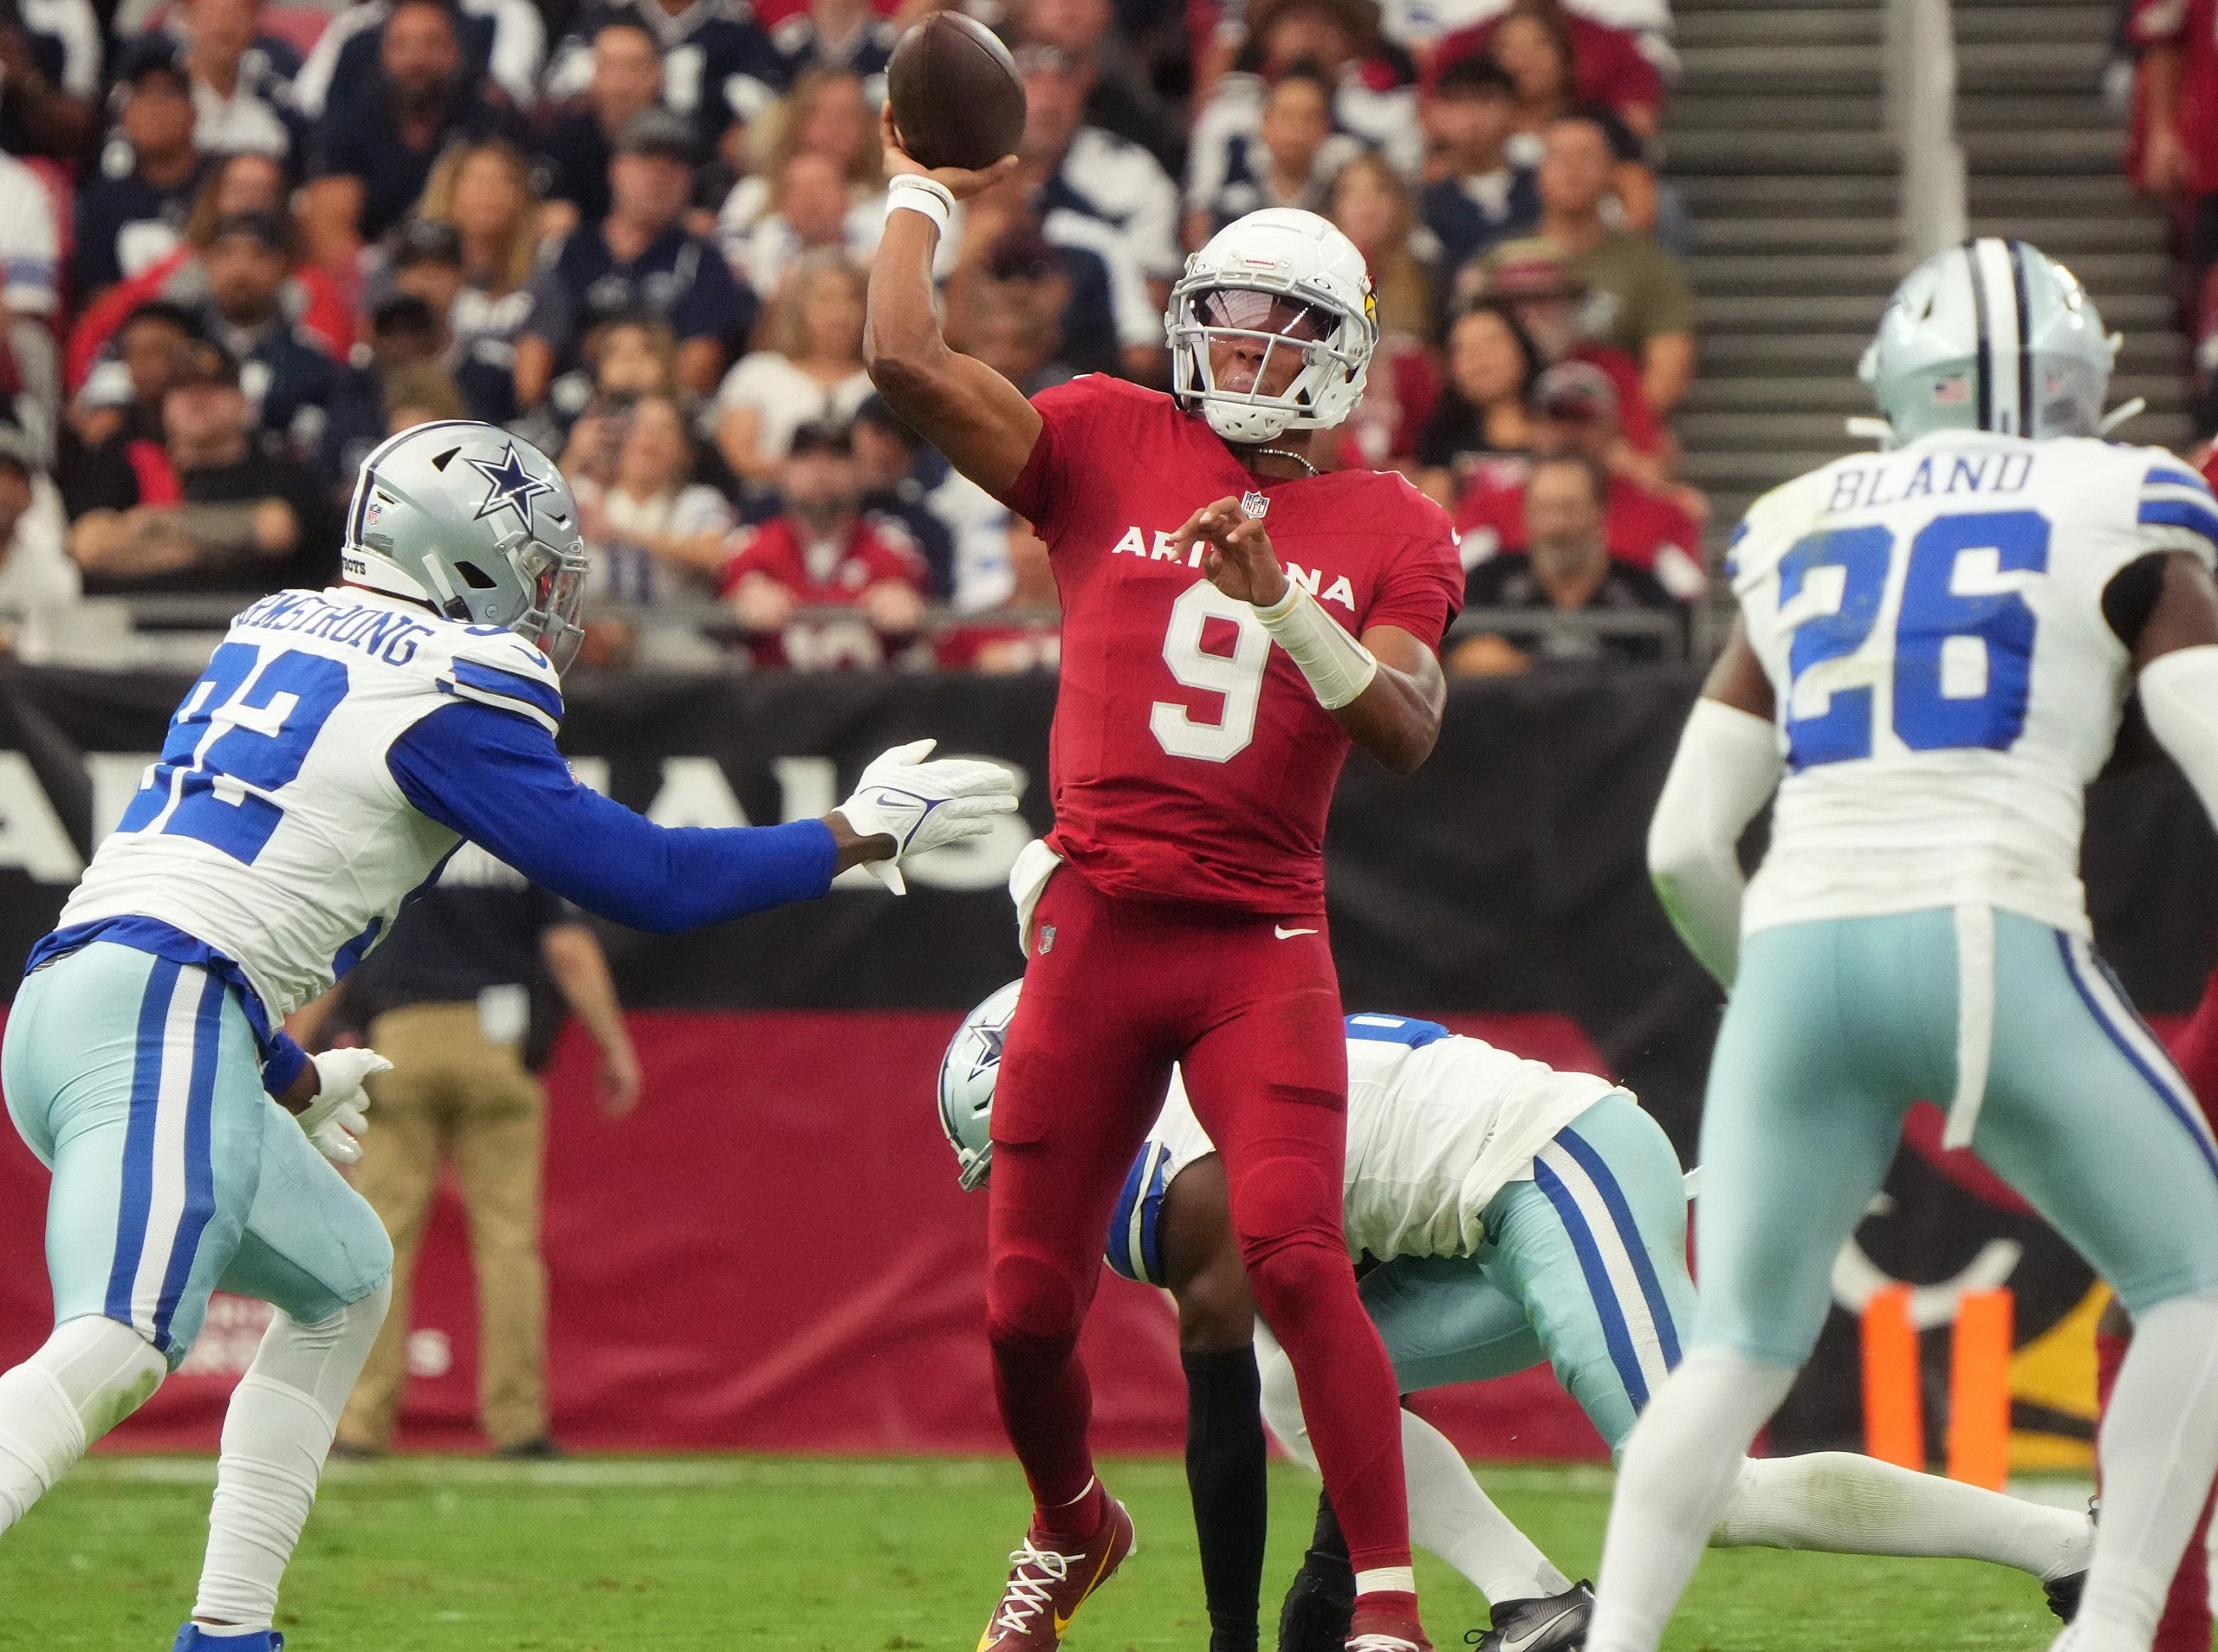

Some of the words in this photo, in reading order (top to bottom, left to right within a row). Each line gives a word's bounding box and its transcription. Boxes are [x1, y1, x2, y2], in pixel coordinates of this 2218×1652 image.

[1245, 499, 1263, 514] NFL
[1826, 453, 2034, 514] BLAND
[1112, 526, 1356, 612] ARINA
[237, 592, 436, 667] RMSTRONG
[1149, 578, 1273, 763] 9
[1778, 508, 2052, 775] 26
[115, 642, 350, 866] 92
